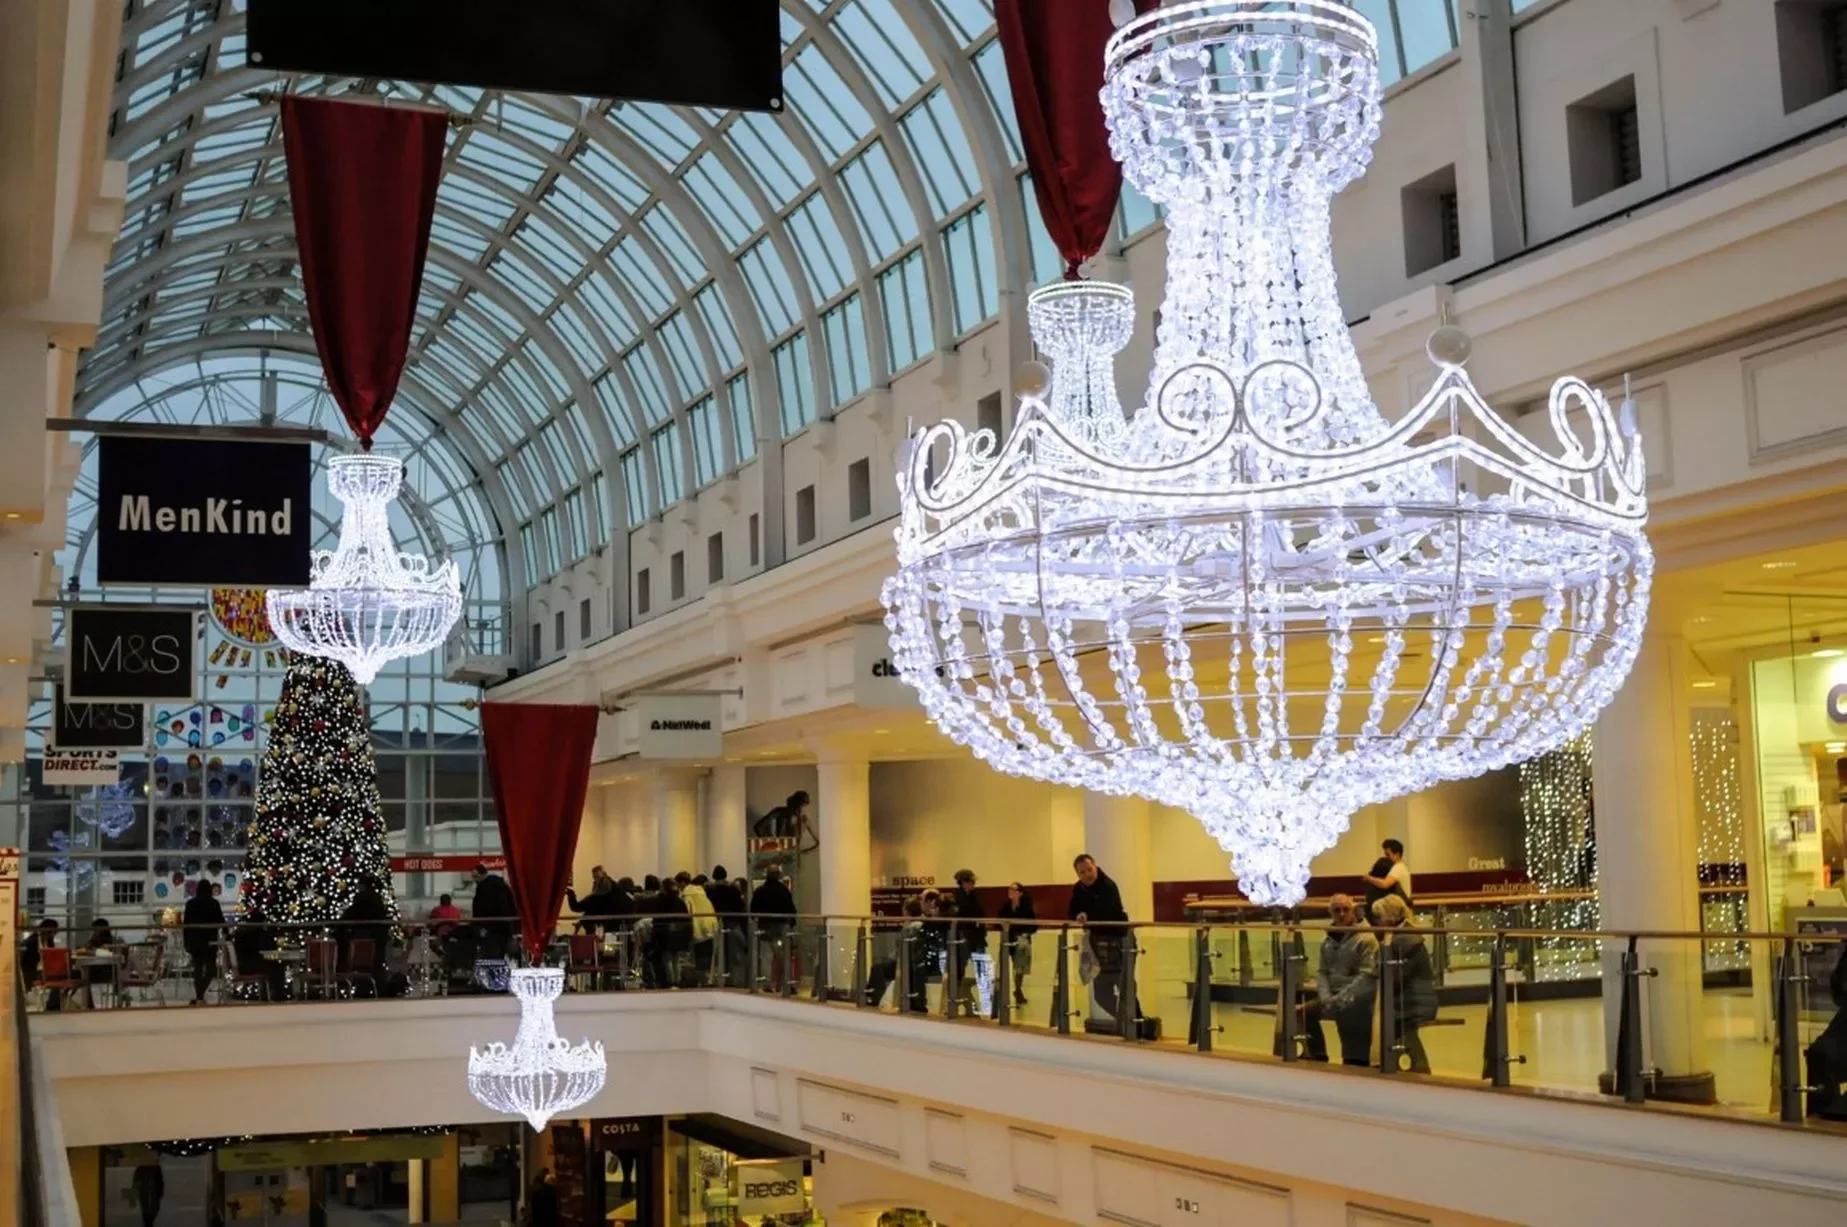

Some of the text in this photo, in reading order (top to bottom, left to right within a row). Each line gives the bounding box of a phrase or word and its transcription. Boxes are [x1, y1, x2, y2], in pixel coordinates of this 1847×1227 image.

[118, 494, 292, 536] MenKind
[83, 633, 180, 674] M&S
[64, 703, 135, 730] M&S
[892, 875, 935, 889] space
[602, 1122, 640, 1135] COSTA
